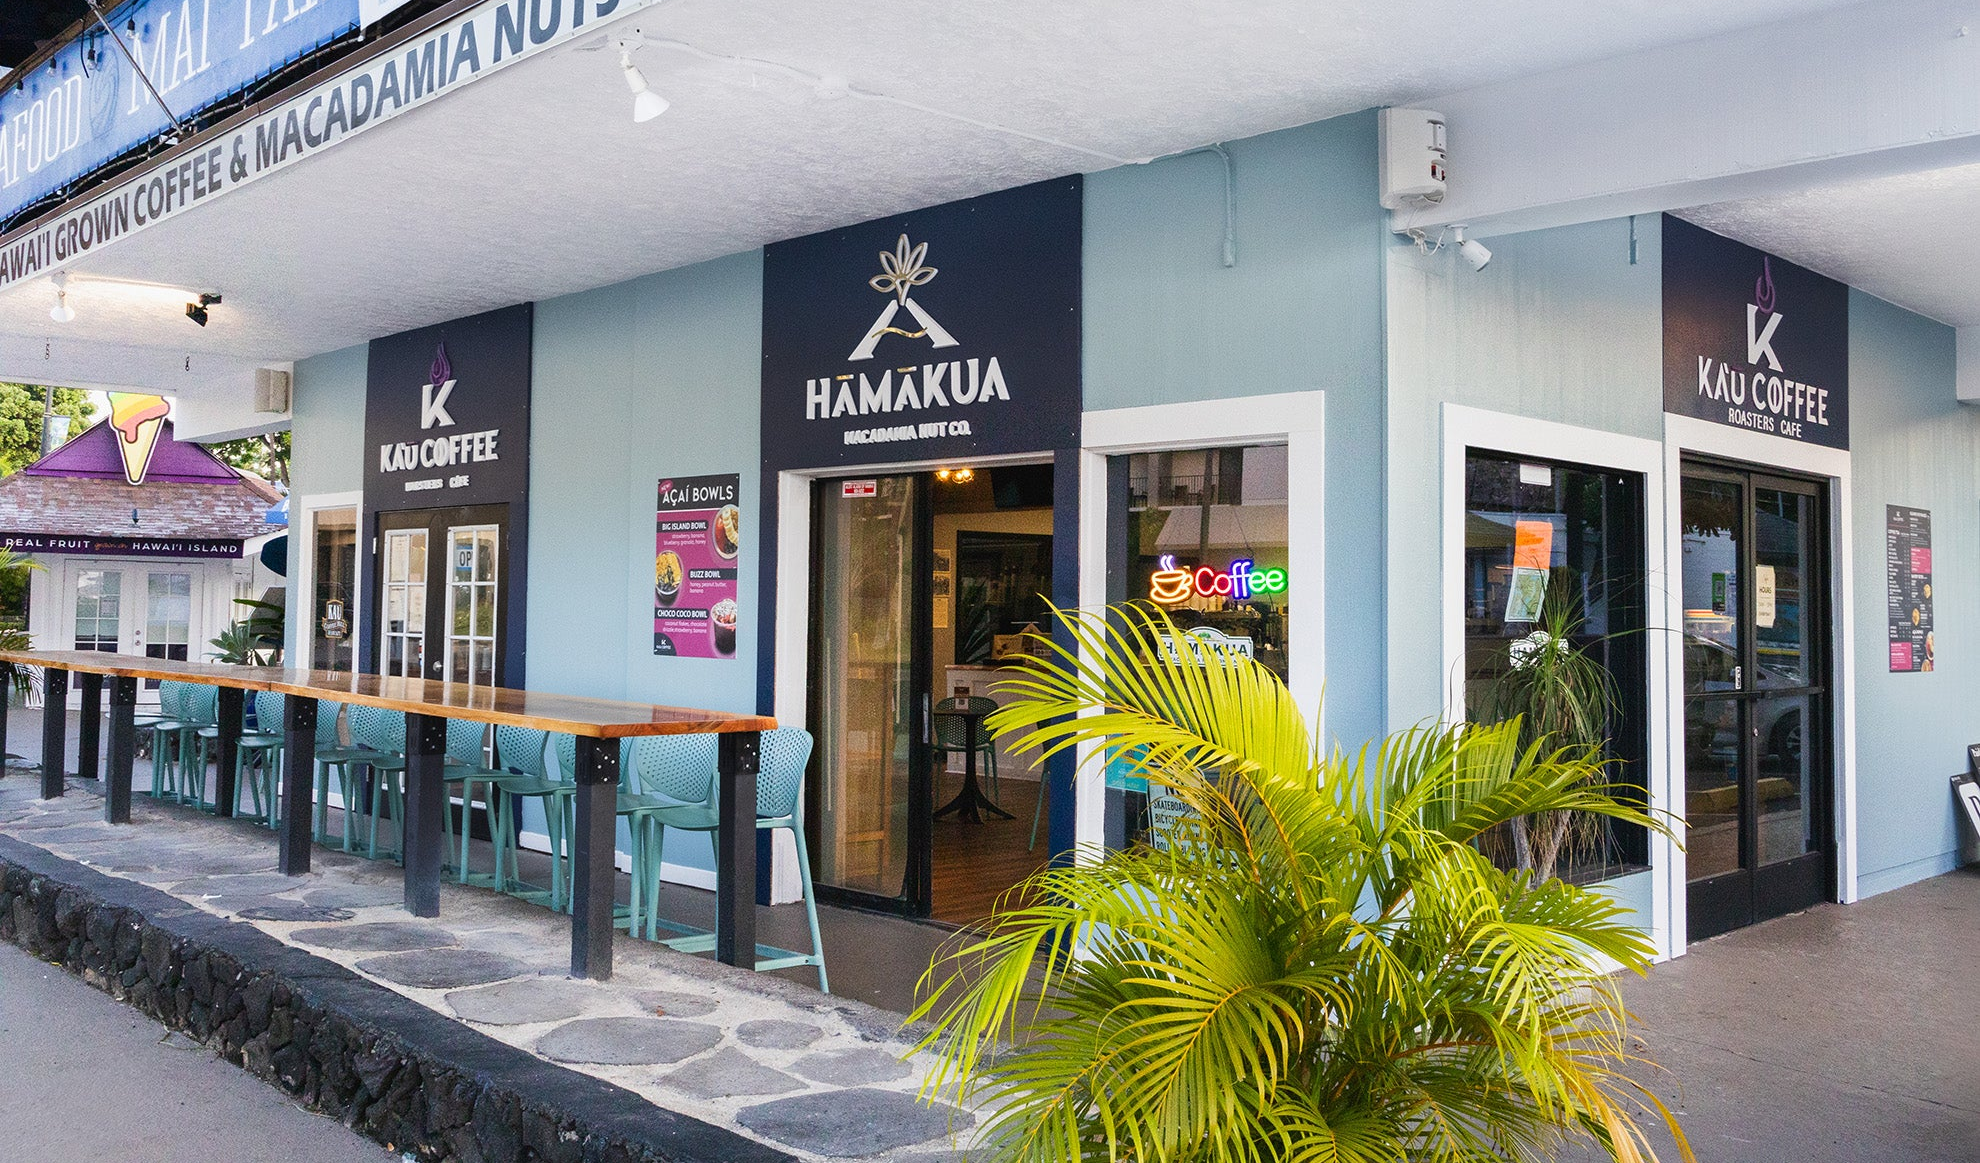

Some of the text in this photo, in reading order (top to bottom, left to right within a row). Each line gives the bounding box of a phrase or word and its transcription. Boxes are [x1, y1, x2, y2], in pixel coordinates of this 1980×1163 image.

[55, 192, 129, 262] GROWN
[134, 149, 222, 227] COFFEE
[230, 135, 249, 183] &
[256, 20, 481, 171] MACADAMIA
[1747, 303, 1784, 372] K
[421, 379, 457, 429] K
[1751, 372, 1829, 426] COFFEE
[844, 424, 918, 445] MACADAMIA
[918, 421, 948, 439] NUT
[1728, 408, 1802, 438] ROASTERS CAFE
[420, 429, 499, 468] COFFEE
[692, 485, 733, 502] BOWLS
[662, 522, 707, 531] BIG ISLAND BOWL
[6, 538, 43, 547] REAL
[50, 539, 90, 549] FRUIT
[188, 544, 238, 553] ISLAND
[460, 551, 473, 566] OP
[690, 570, 721, 578] BUZZ BOWL
[1194, 561, 1286, 598] Coffee
[657, 609, 708, 618] CHOCO COCO BOWL
[1163, 641, 1249, 657] HMKUA
